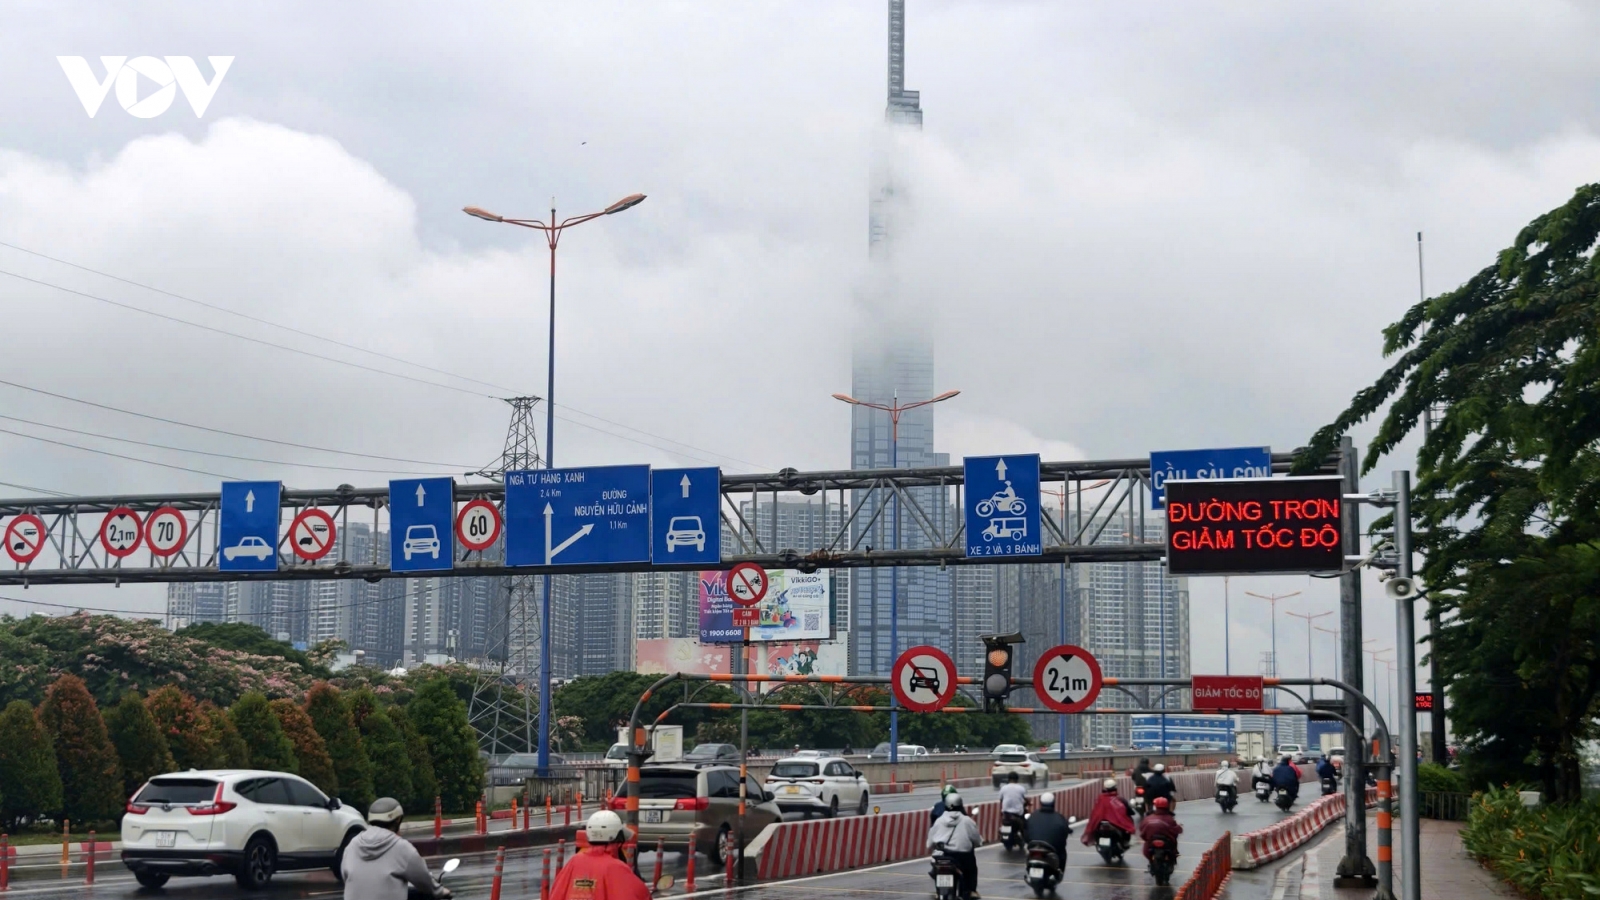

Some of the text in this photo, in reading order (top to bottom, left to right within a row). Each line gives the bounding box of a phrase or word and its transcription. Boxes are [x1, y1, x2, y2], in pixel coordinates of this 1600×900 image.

[509, 472, 585, 485] NGÃ TƯ HÀNG XANH
[552, 489, 562, 497] Km
[602, 488, 627, 500] ĐƯỜNG
[574, 501, 648, 517] NGUYỄN HỮU CẢNH
[1168, 499, 1339, 523] ĐƯỜNG TRƠN
[158, 522, 174, 542] 70
[469, 515, 487, 537] 60
[1172, 523, 1339, 553] GIẢM TỐC ĐỘ
[970, 542, 1040, 555] XE 2 VÀ 3 BÁNH
[1048, 668, 1088, 693] 2,1m
[1194, 685, 1260, 700] GIẢM TỐC ĐỘ
